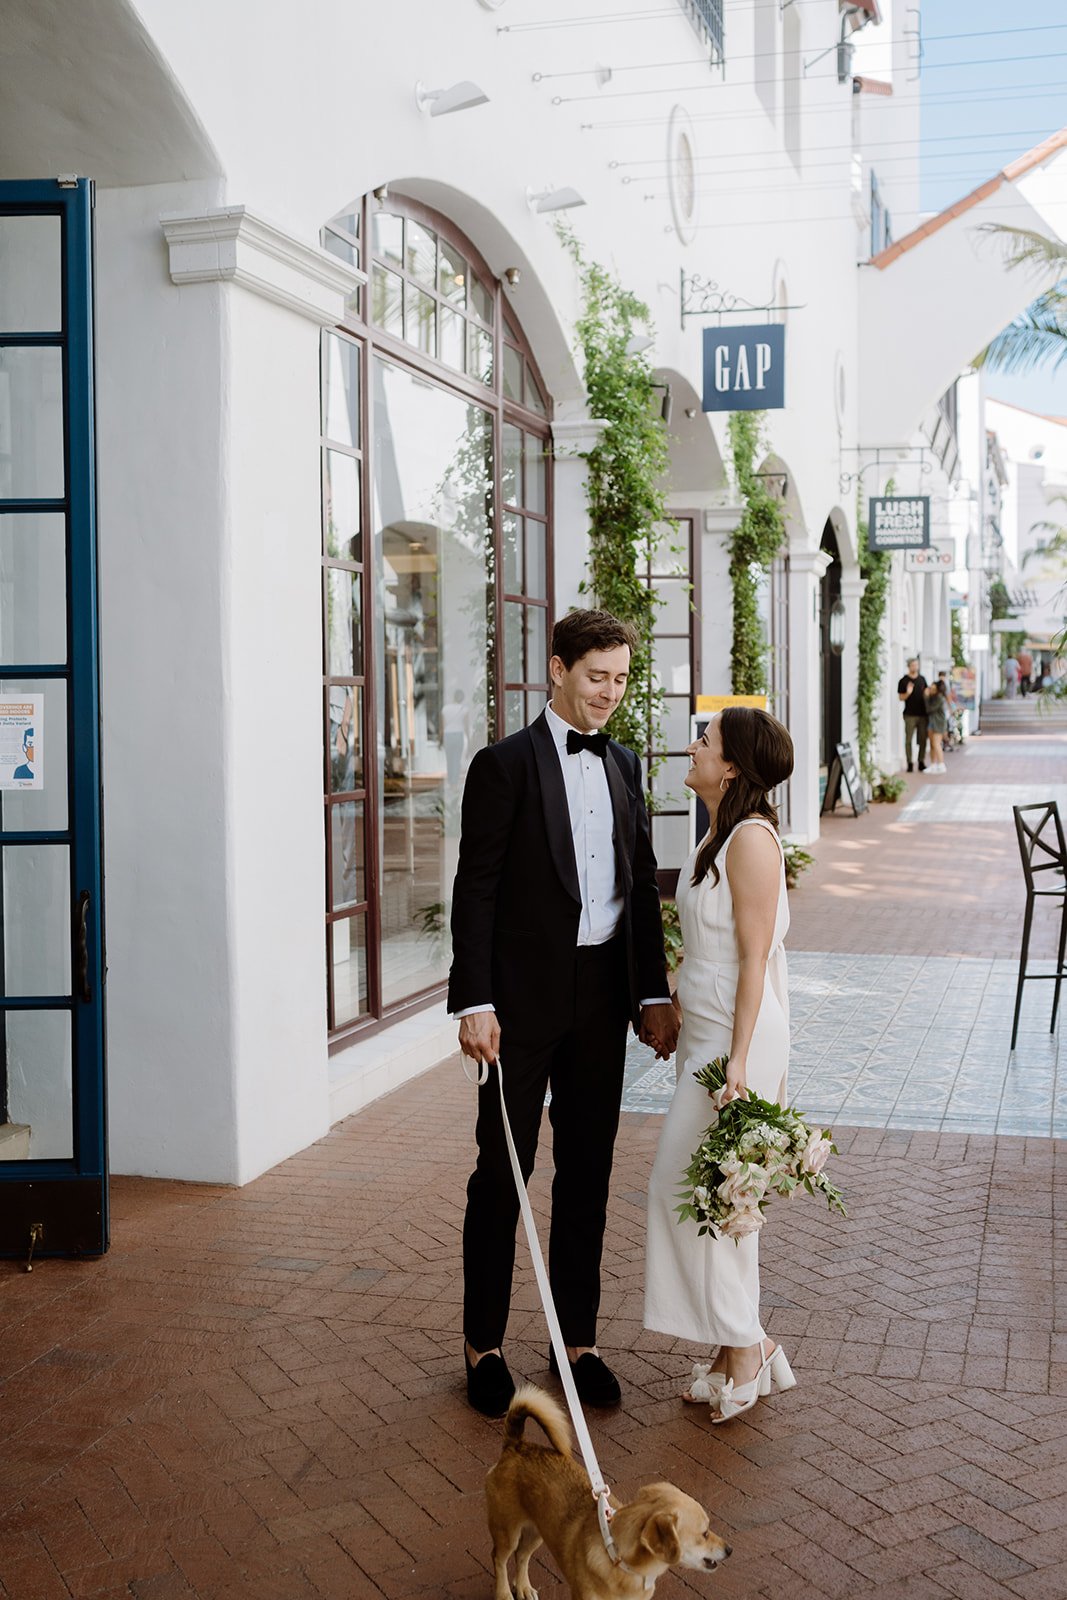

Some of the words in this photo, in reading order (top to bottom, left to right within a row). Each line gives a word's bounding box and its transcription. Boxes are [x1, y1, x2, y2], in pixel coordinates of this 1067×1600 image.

[715, 343, 772, 392] GAP
[875, 501, 924, 515] LUSH
[875, 515, 924, 528] FRESH
[910, 552, 952, 564] TOKYO
